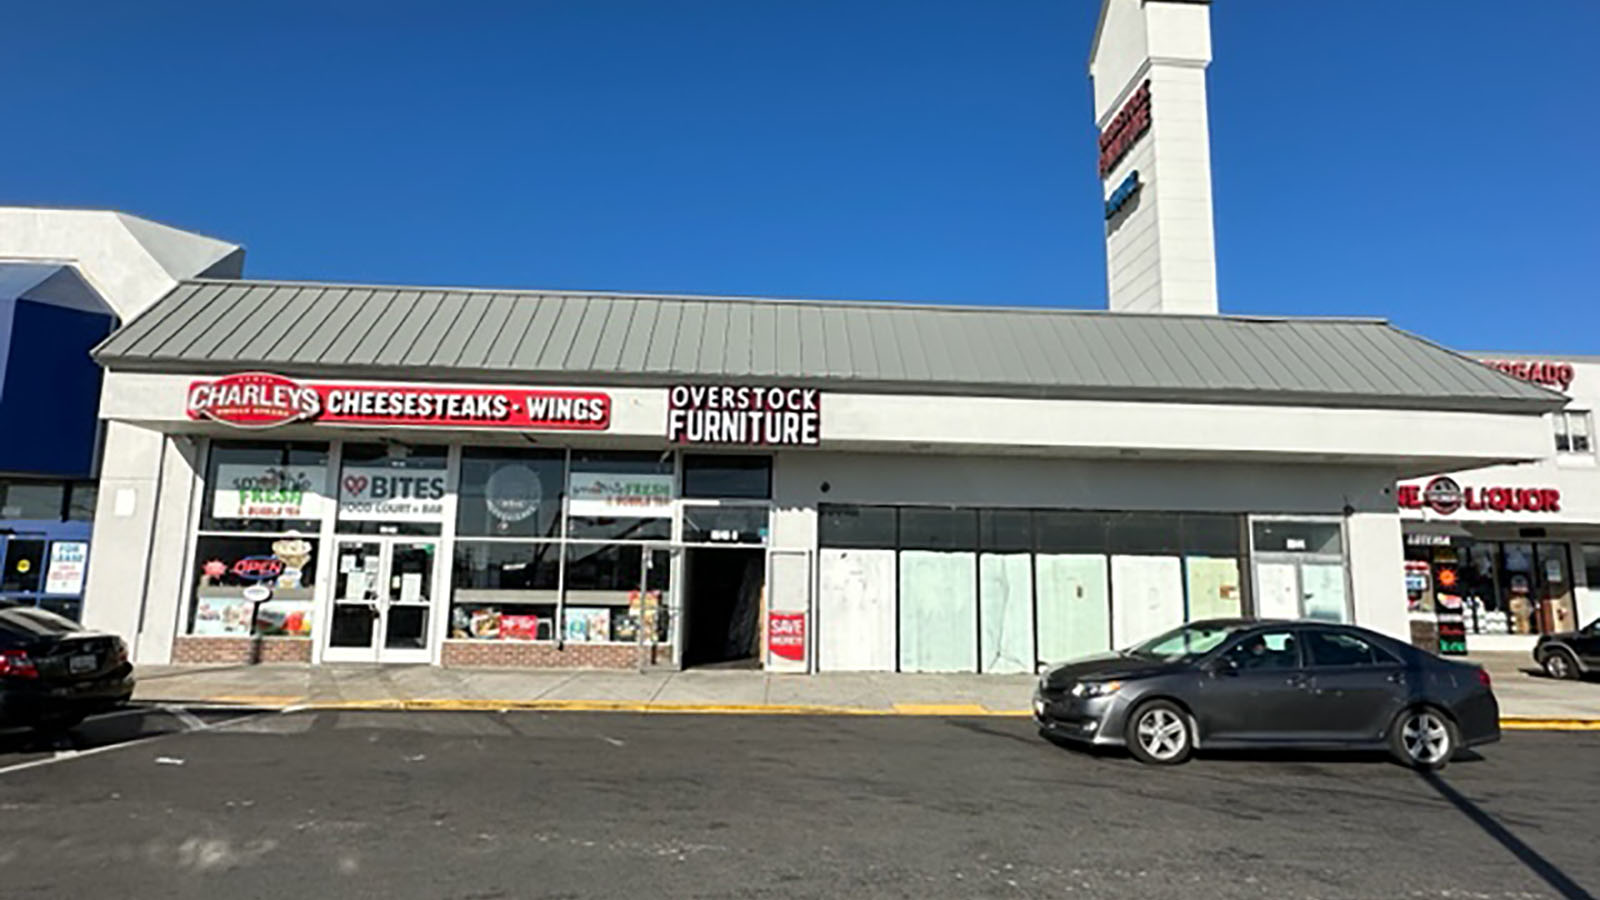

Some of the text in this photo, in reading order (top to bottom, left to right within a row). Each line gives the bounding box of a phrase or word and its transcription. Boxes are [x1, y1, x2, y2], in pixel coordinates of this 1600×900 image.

[190, 384, 320, 415] CHARLEYS
[327, 390, 603, 420] CHEESESTEAKS WINGS
[669, 386, 818, 444] OVERSTOCK FURNITURE
[370, 476, 444, 500] BITES
[375, 503, 411, 514] COURT
[234, 558, 282, 574] OPEN
[771, 619, 803, 634] SAVE
